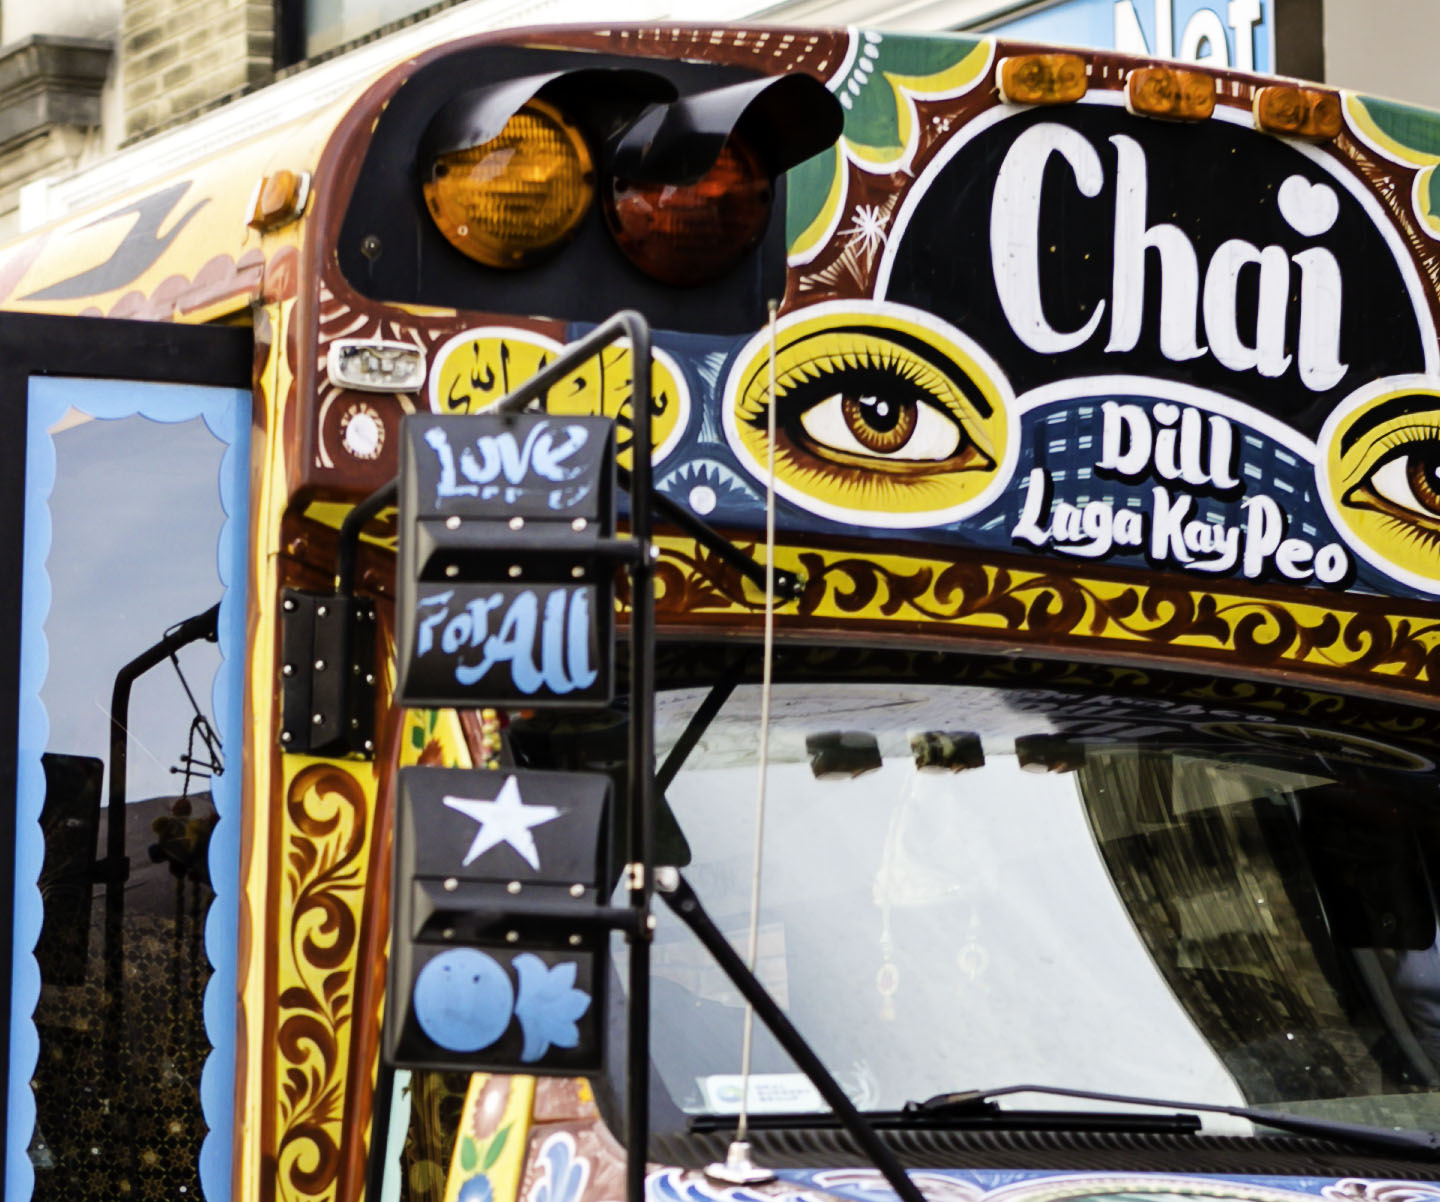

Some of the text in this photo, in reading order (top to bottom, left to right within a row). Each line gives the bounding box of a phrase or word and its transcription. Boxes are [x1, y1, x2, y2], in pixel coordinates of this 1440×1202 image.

[989, 120, 1350, 393] Chai
[1095, 400, 1240, 490] Dill
[1011, 467, 1349, 584] Laga Kay Peo
[454, 587, 598, 694] All
